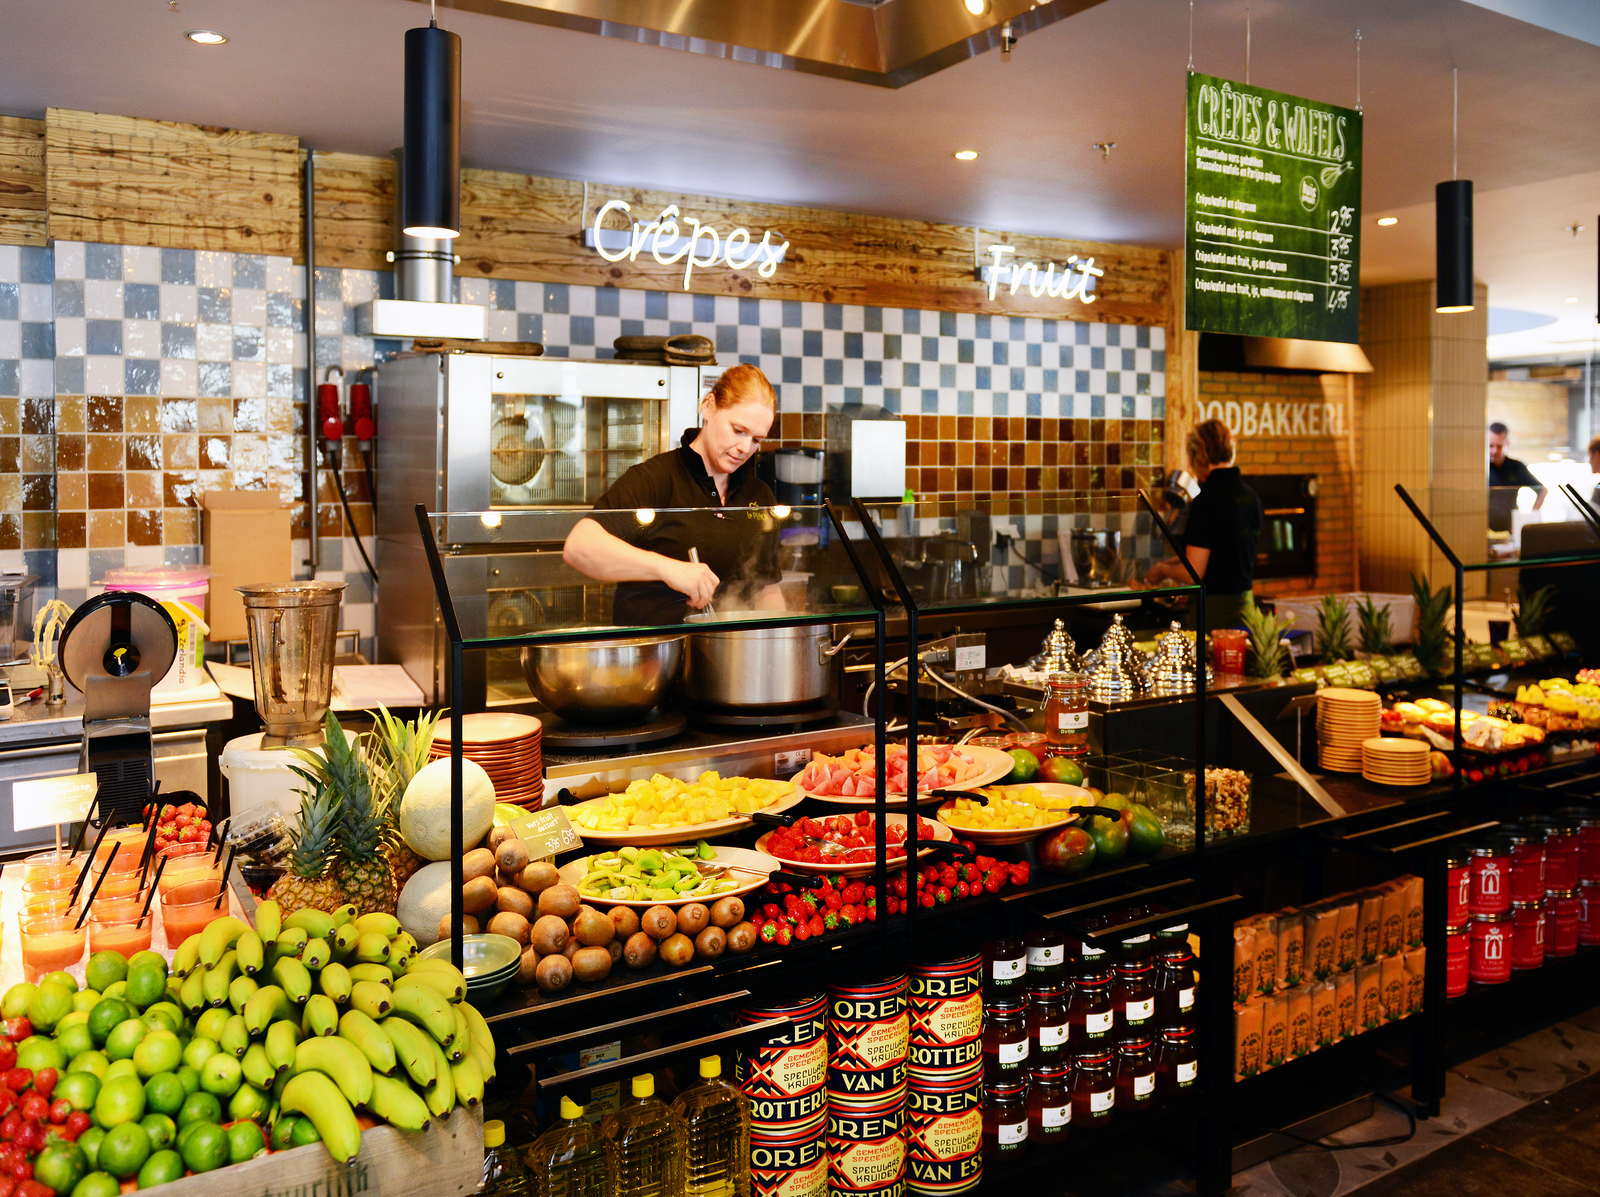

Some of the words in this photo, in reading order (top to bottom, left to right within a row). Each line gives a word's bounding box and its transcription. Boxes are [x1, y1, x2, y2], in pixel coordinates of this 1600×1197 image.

[1198, 82, 1262, 144] CRÊPES
[1266, 100, 1281, 149] &
[1282, 102, 1347, 162] WAFELS
[594, 200, 789, 291] Crêpes
[988, 245, 1104, 304] Fruit
[179, 637, 187, 684] Zeelandia
[526, 820, 540, 829] Vers
[540, 813, 554, 824] fruit
[538, 818, 558, 832] dessert
[945, 1023, 979, 1038] KRUIDEN
[872, 1045, 906, 1063] KRUIDEN
[788, 1071, 824, 1089] KRUIDEN
[841, 1072, 884, 1091] VAN
[938, 1115, 977, 1129] GEMENGDE
[934, 1129, 978, 1147] SPECULAAS
[938, 1139, 977, 1155] KRUIDEN
[856, 1141, 898, 1156] GEMENGDE
[852, 1157, 900, 1174] SPECULAAS
[911, 1161, 951, 1181] VAN
[856, 1167, 898, 1183] KRUIDEN
